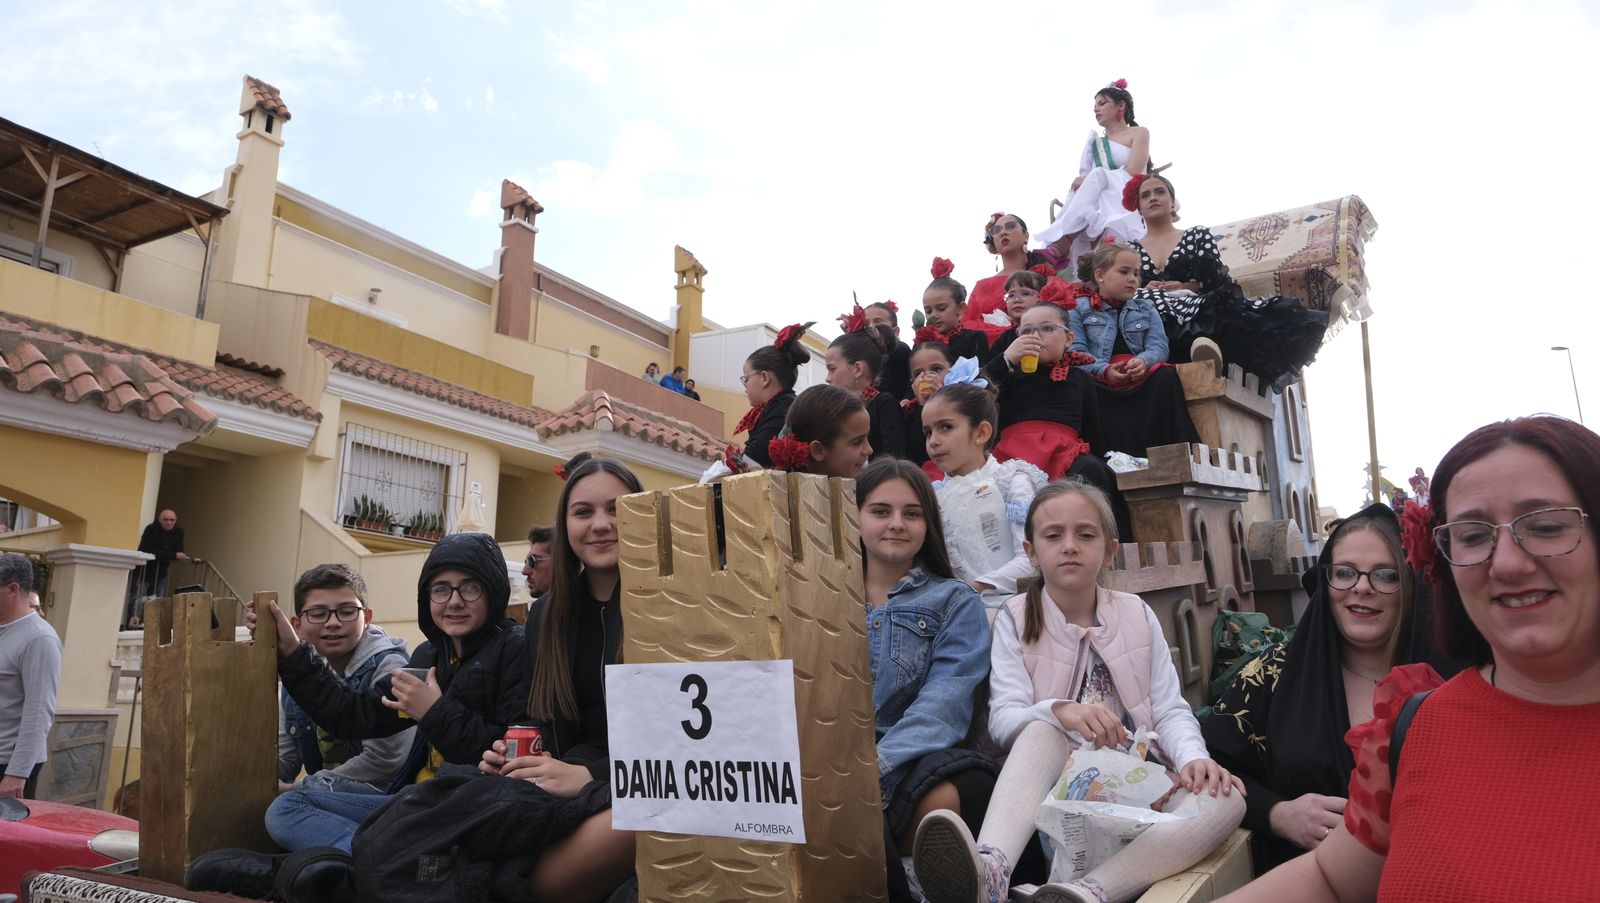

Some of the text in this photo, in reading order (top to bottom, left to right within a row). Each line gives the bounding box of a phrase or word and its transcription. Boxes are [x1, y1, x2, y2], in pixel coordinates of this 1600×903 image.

[680, 673, 713, 741] 3
[614, 759, 798, 805] DAMA CRISTINA
[734, 822, 794, 836] ALFOMBRA
